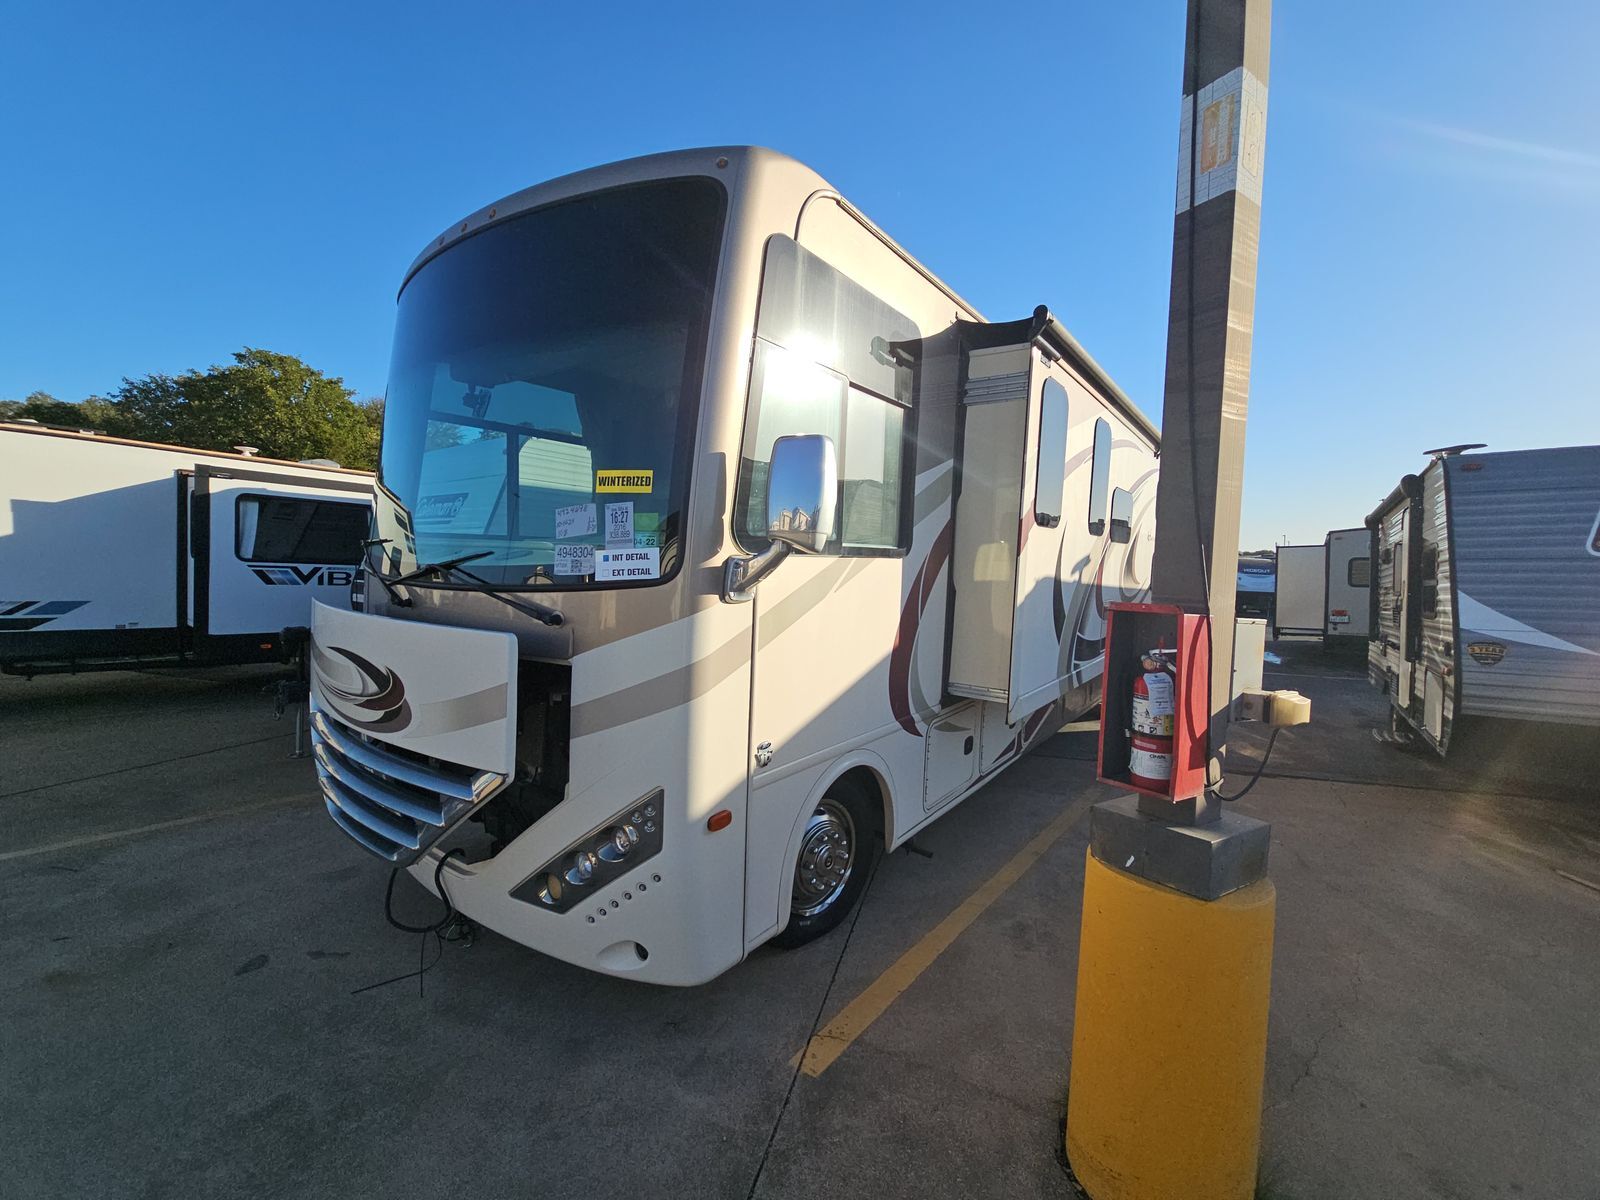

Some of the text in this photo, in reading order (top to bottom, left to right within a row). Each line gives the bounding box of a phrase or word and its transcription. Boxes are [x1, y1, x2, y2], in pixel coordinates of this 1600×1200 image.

[598, 476, 651, 487] WINTERIZED
[610, 511, 629, 524] 16:27
[557, 547, 594, 558] 4948304
[626, 553, 650, 561] DETAIL
[290, 566, 353, 586] VIB
[627, 568, 652, 576] DETAIL
